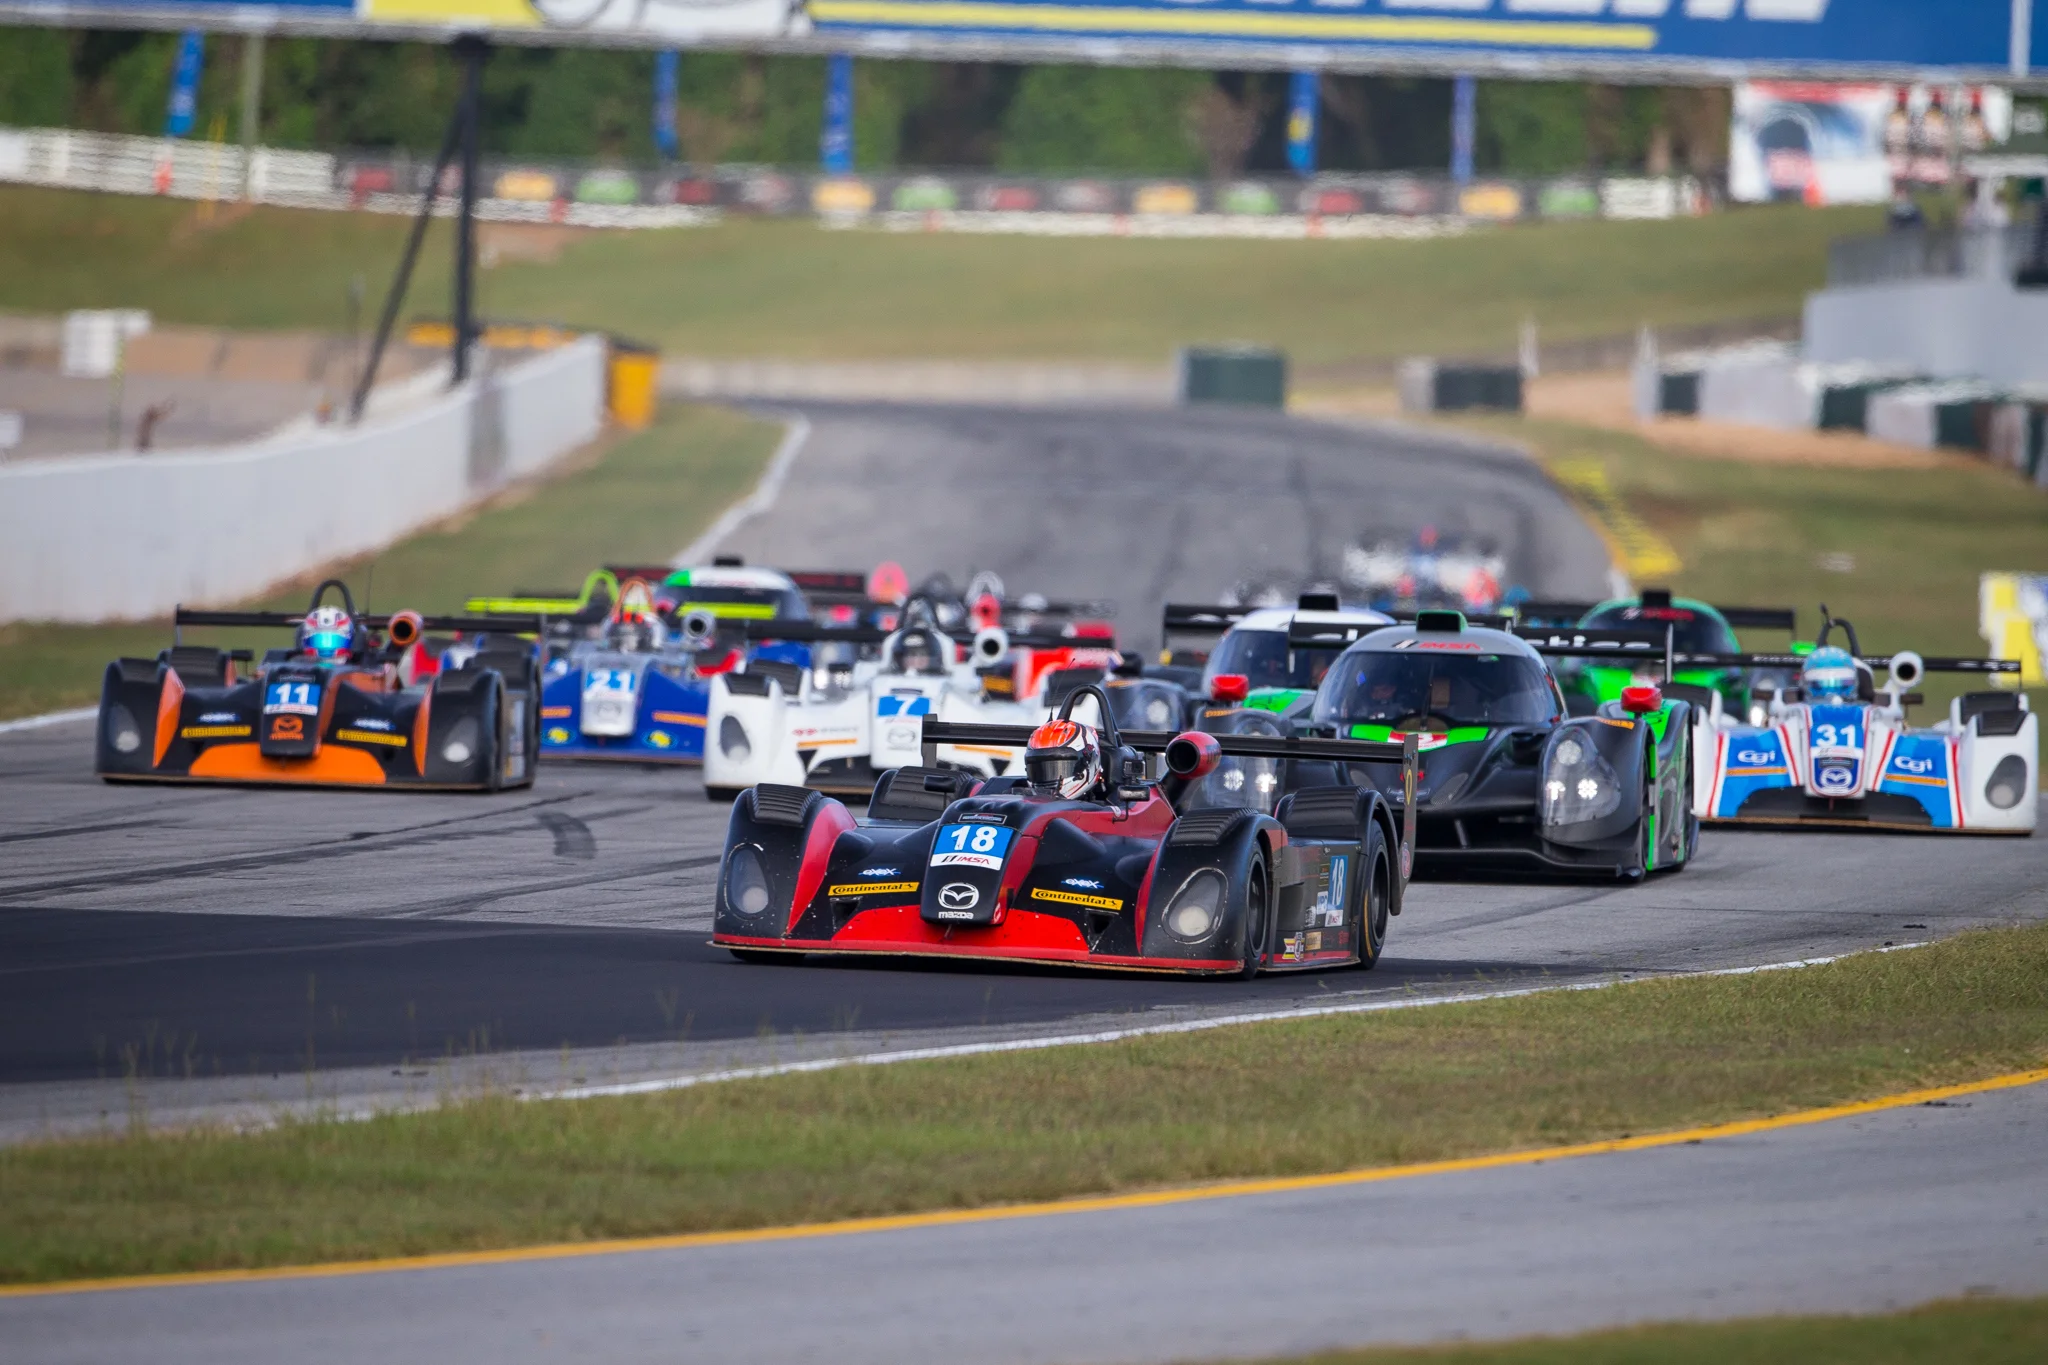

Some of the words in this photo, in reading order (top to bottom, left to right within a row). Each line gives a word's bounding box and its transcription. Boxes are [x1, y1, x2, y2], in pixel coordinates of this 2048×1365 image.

[592, 669, 630, 692] 21
[276, 682, 310, 705] 11
[894, 696, 919, 718] 7
[1816, 723, 1856, 748] 31
[950, 825, 998, 852] 18
[832, 883, 904, 895] Continental
[1331, 858, 1345, 906] 18
[1034, 890, 1107, 906] Continental
